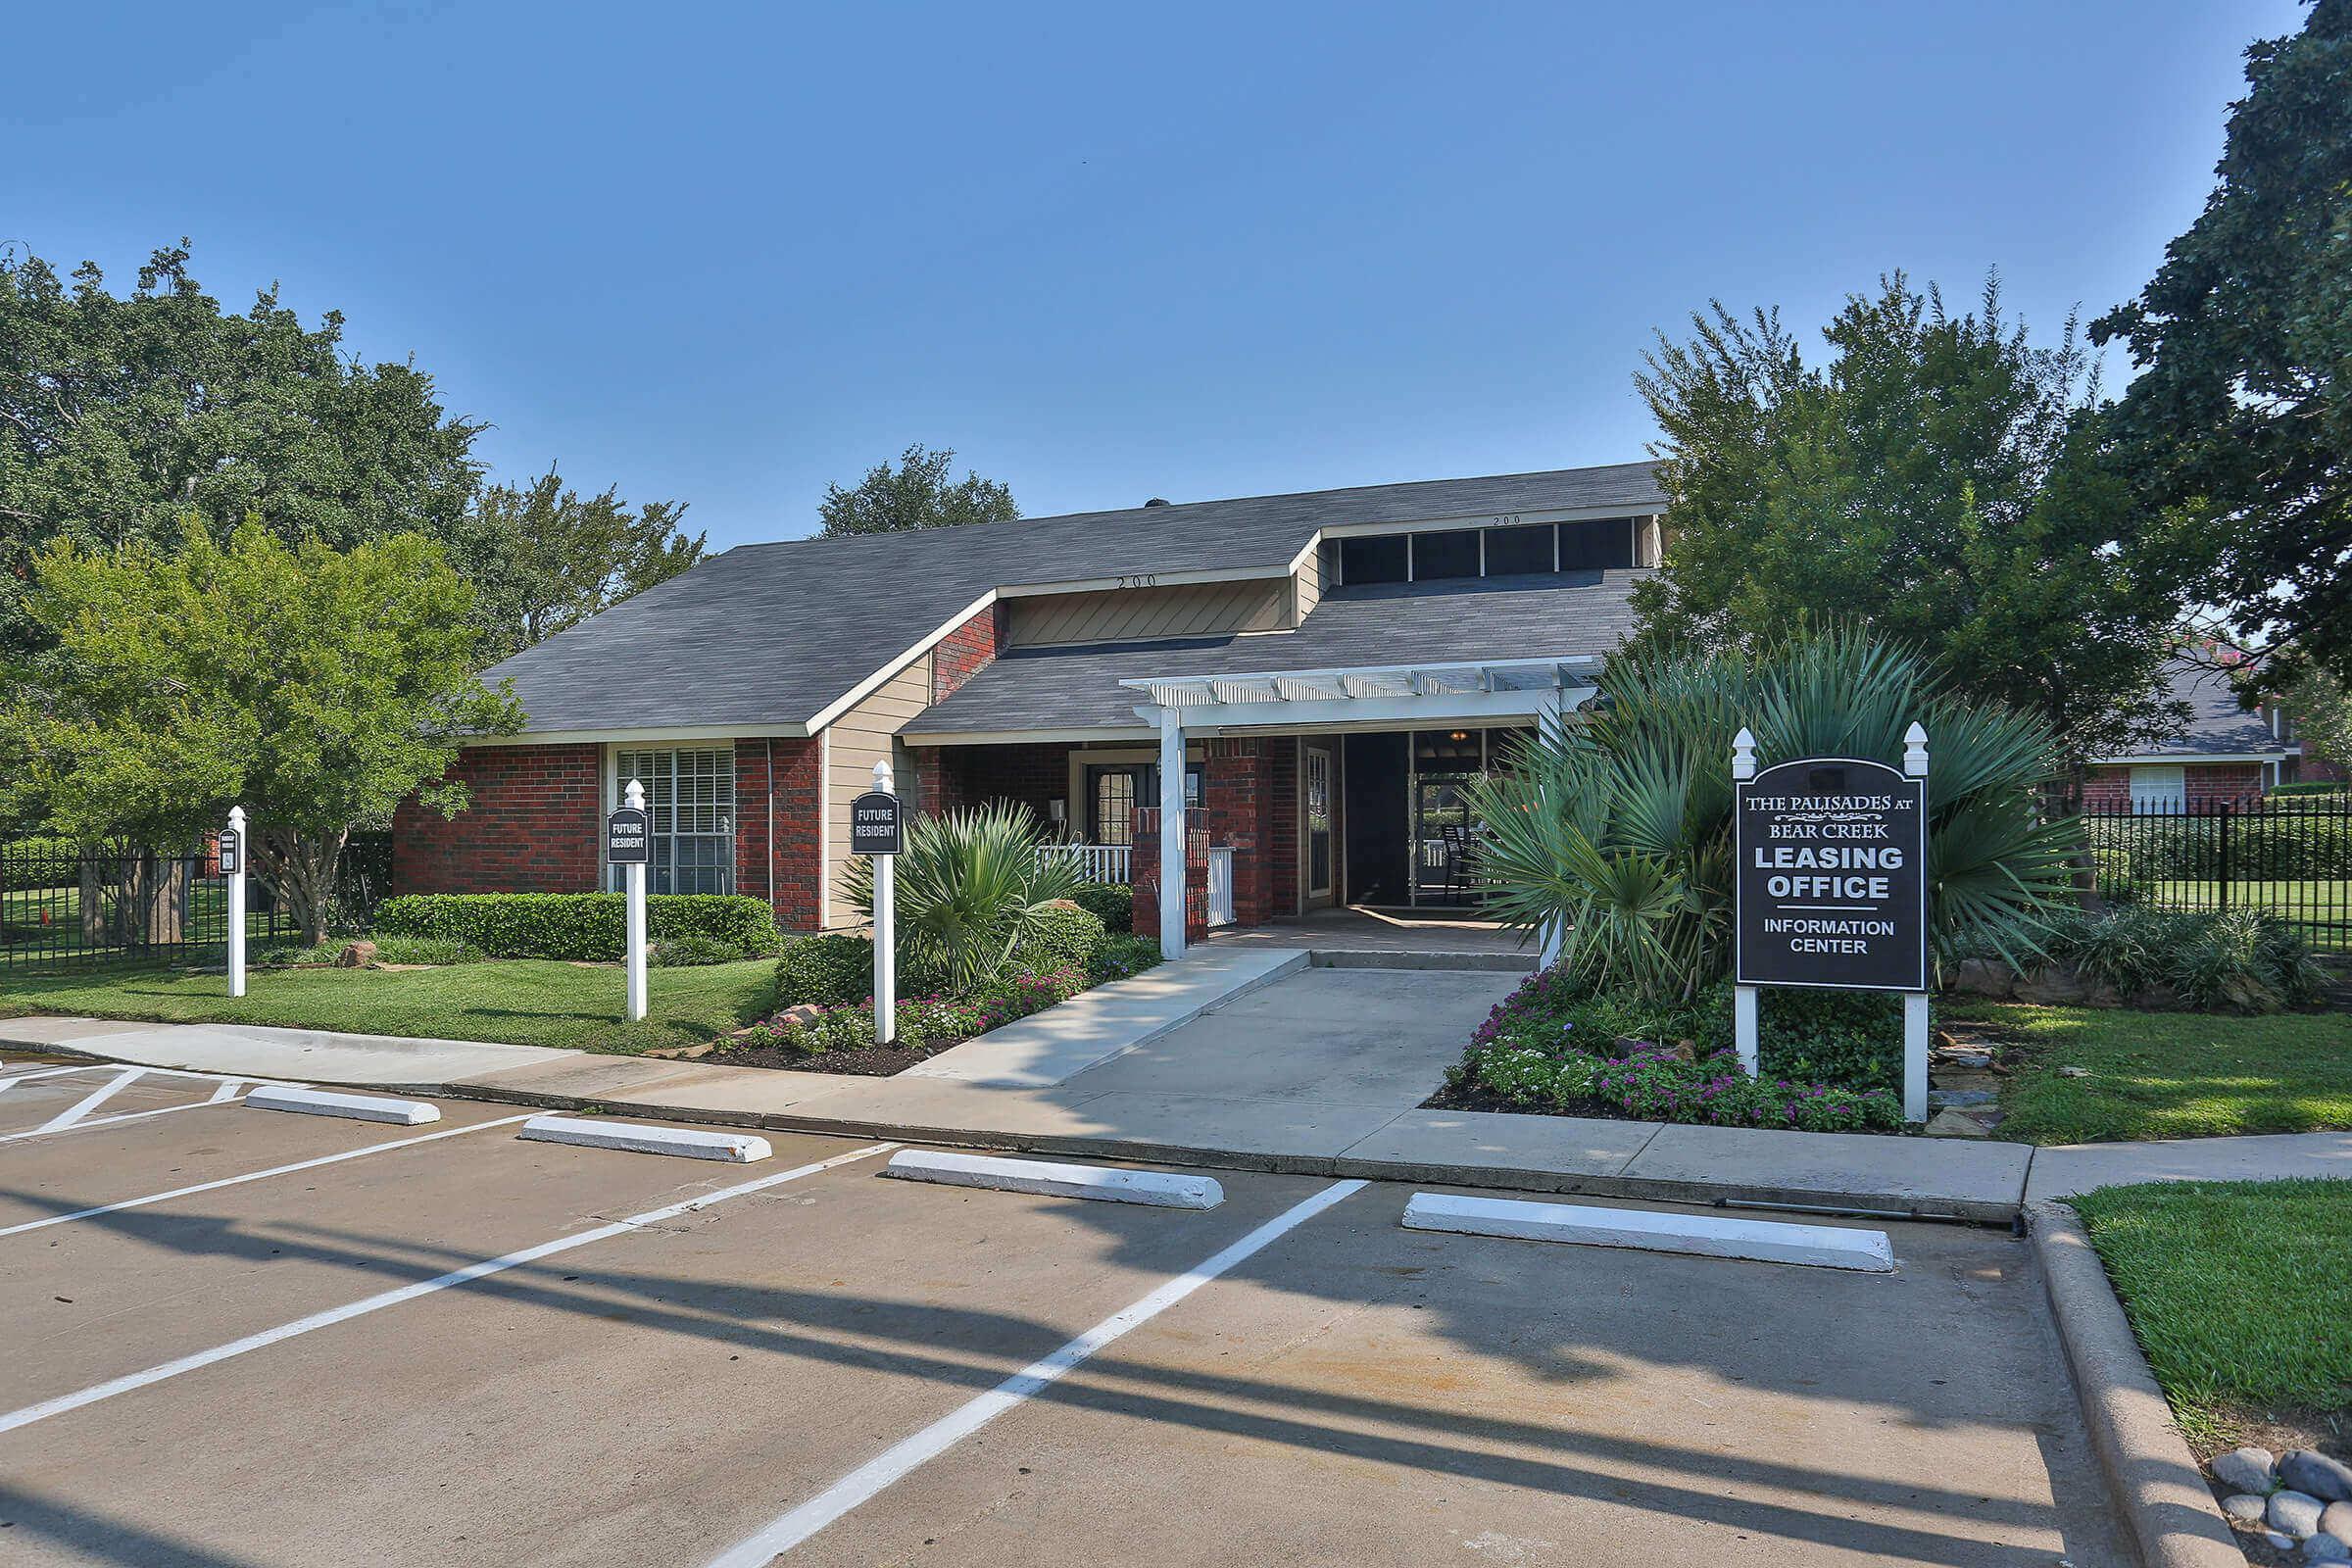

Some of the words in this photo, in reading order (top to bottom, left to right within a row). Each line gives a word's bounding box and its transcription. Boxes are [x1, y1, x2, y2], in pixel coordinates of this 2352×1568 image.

[1493, 514, 1520, 525] 200
[1117, 574, 1155, 589] 200
[1746, 797, 1786, 811] THE
[1791, 795, 1891, 810] PALISADES
[1894, 799, 1913, 809] AT
[858, 808, 893, 821] FUTURE
[612, 823, 643, 834] FUTURE
[856, 824, 895, 837] RESIDENT
[1769, 824, 1819, 839] BEAR
[1822, 823, 1888, 839] CREEK
[611, 837, 644, 849] RESIDENT
[1755, 847, 1903, 869] LEASING
[1767, 875, 1889, 899] OFFICE
[1764, 918, 1894, 936] INFORMATION
[1790, 939, 1868, 955] CENTER
